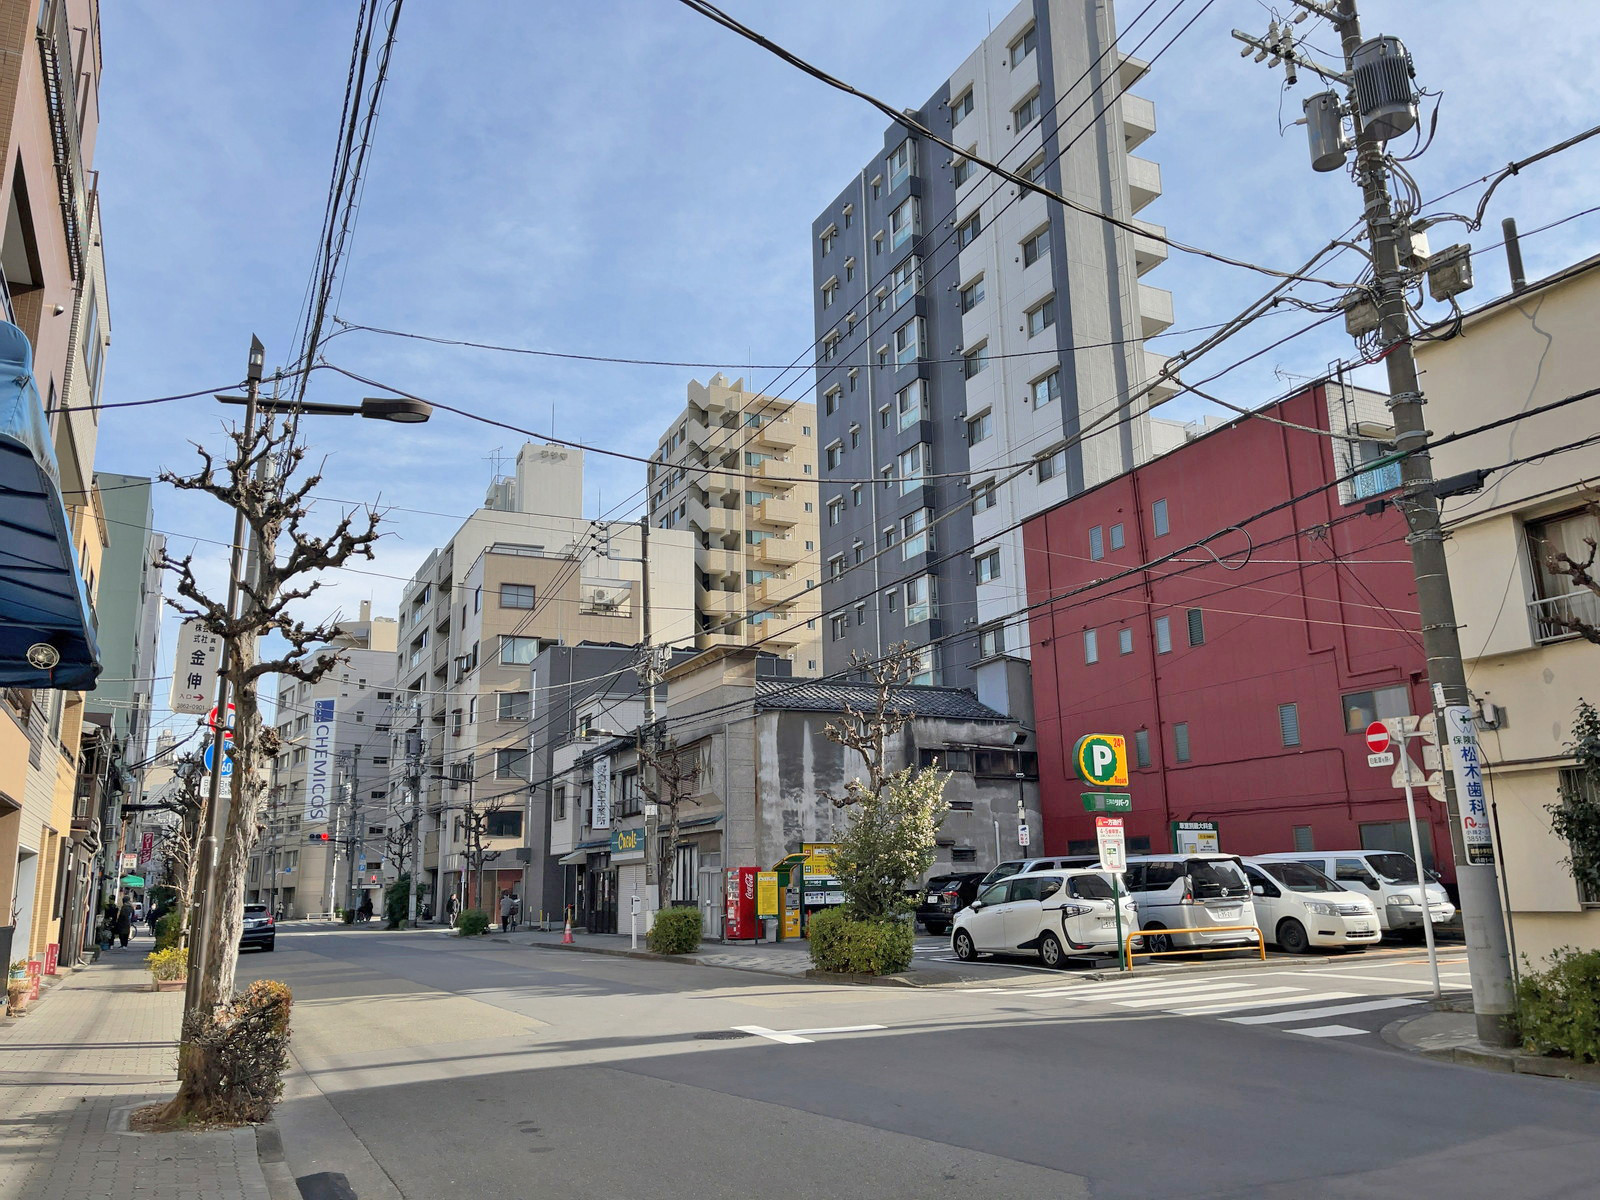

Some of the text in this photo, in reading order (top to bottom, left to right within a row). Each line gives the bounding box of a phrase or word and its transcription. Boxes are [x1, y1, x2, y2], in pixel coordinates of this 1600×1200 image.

[187, 650, 206, 689] 金伸
[1092, 745, 1113, 776] P
[1460, 747, 1485, 816] 松木歯科
[744, 872, 754, 900] Coca-Cola
